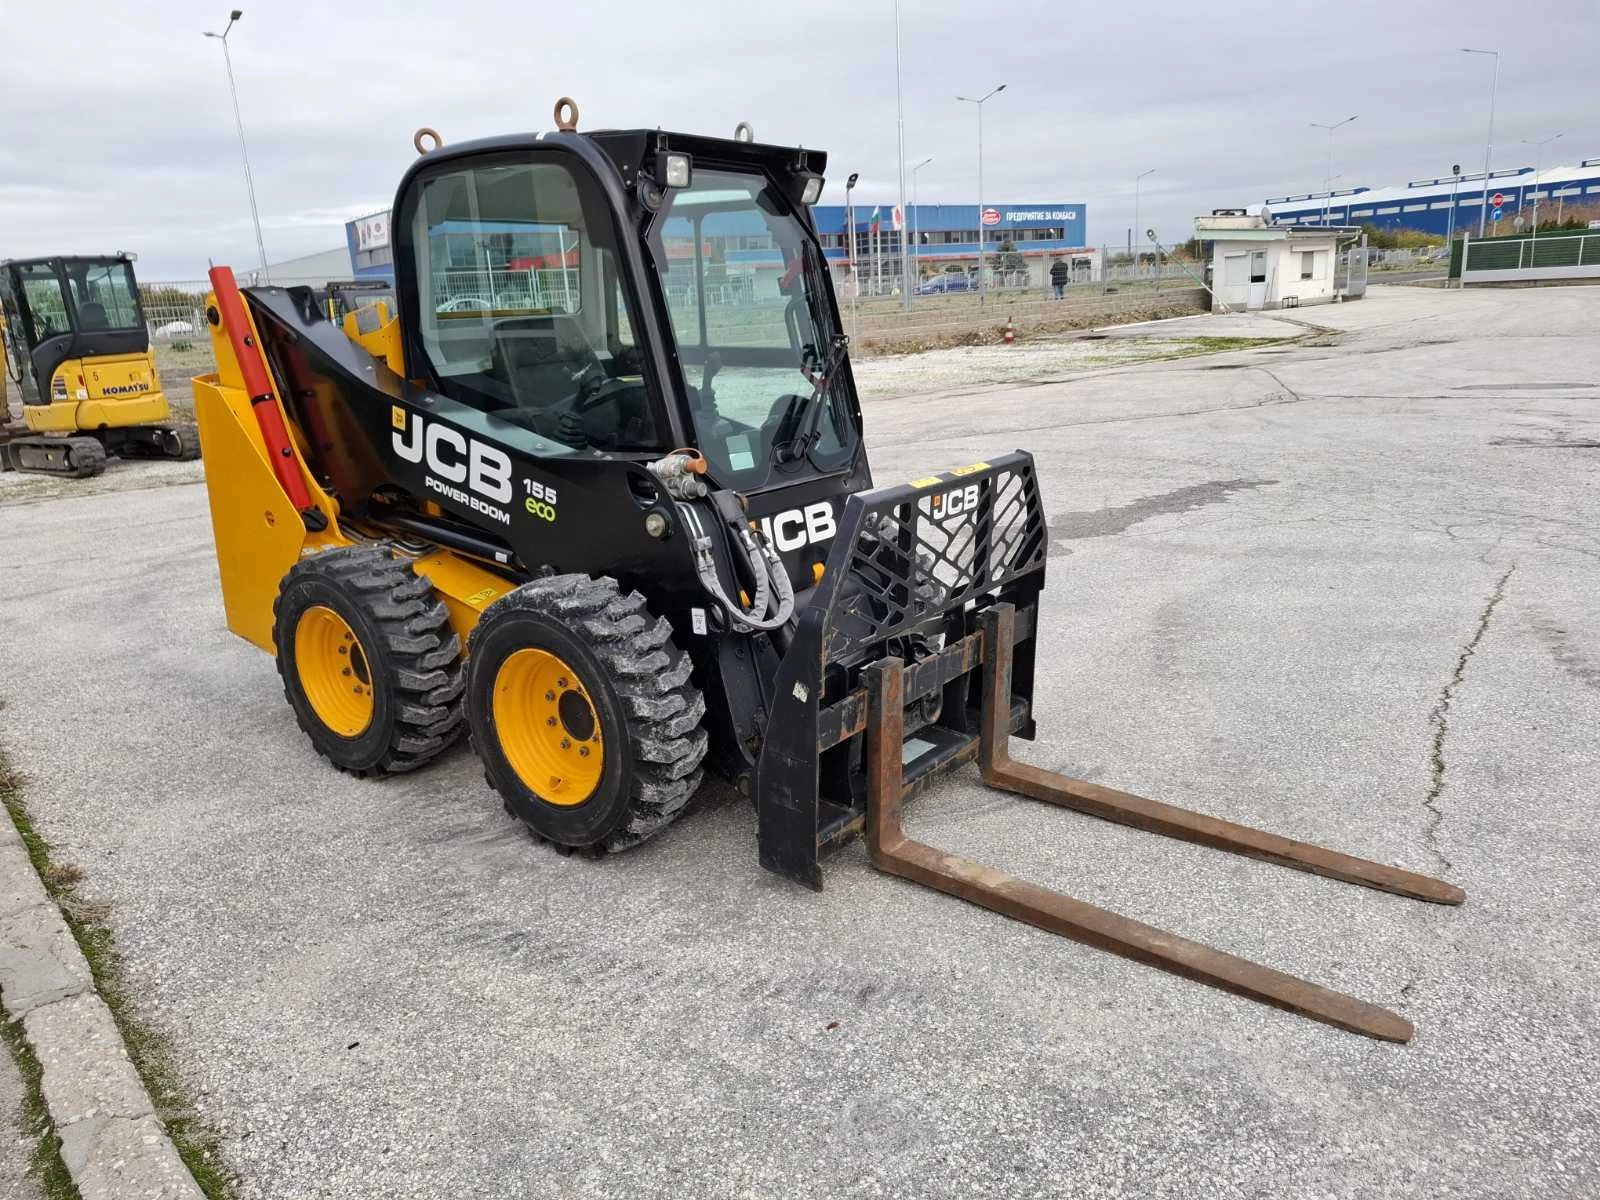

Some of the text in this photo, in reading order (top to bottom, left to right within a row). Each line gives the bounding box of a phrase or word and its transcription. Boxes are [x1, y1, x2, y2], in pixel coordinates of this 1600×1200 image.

[102, 383, 149, 396] KOMATSU
[392, 414, 512, 504] JCB
[425, 475, 510, 526] POWER BOOM
[523, 478, 557, 505] 155
[933, 484, 979, 520] JCB
[525, 497, 556, 522] eco
